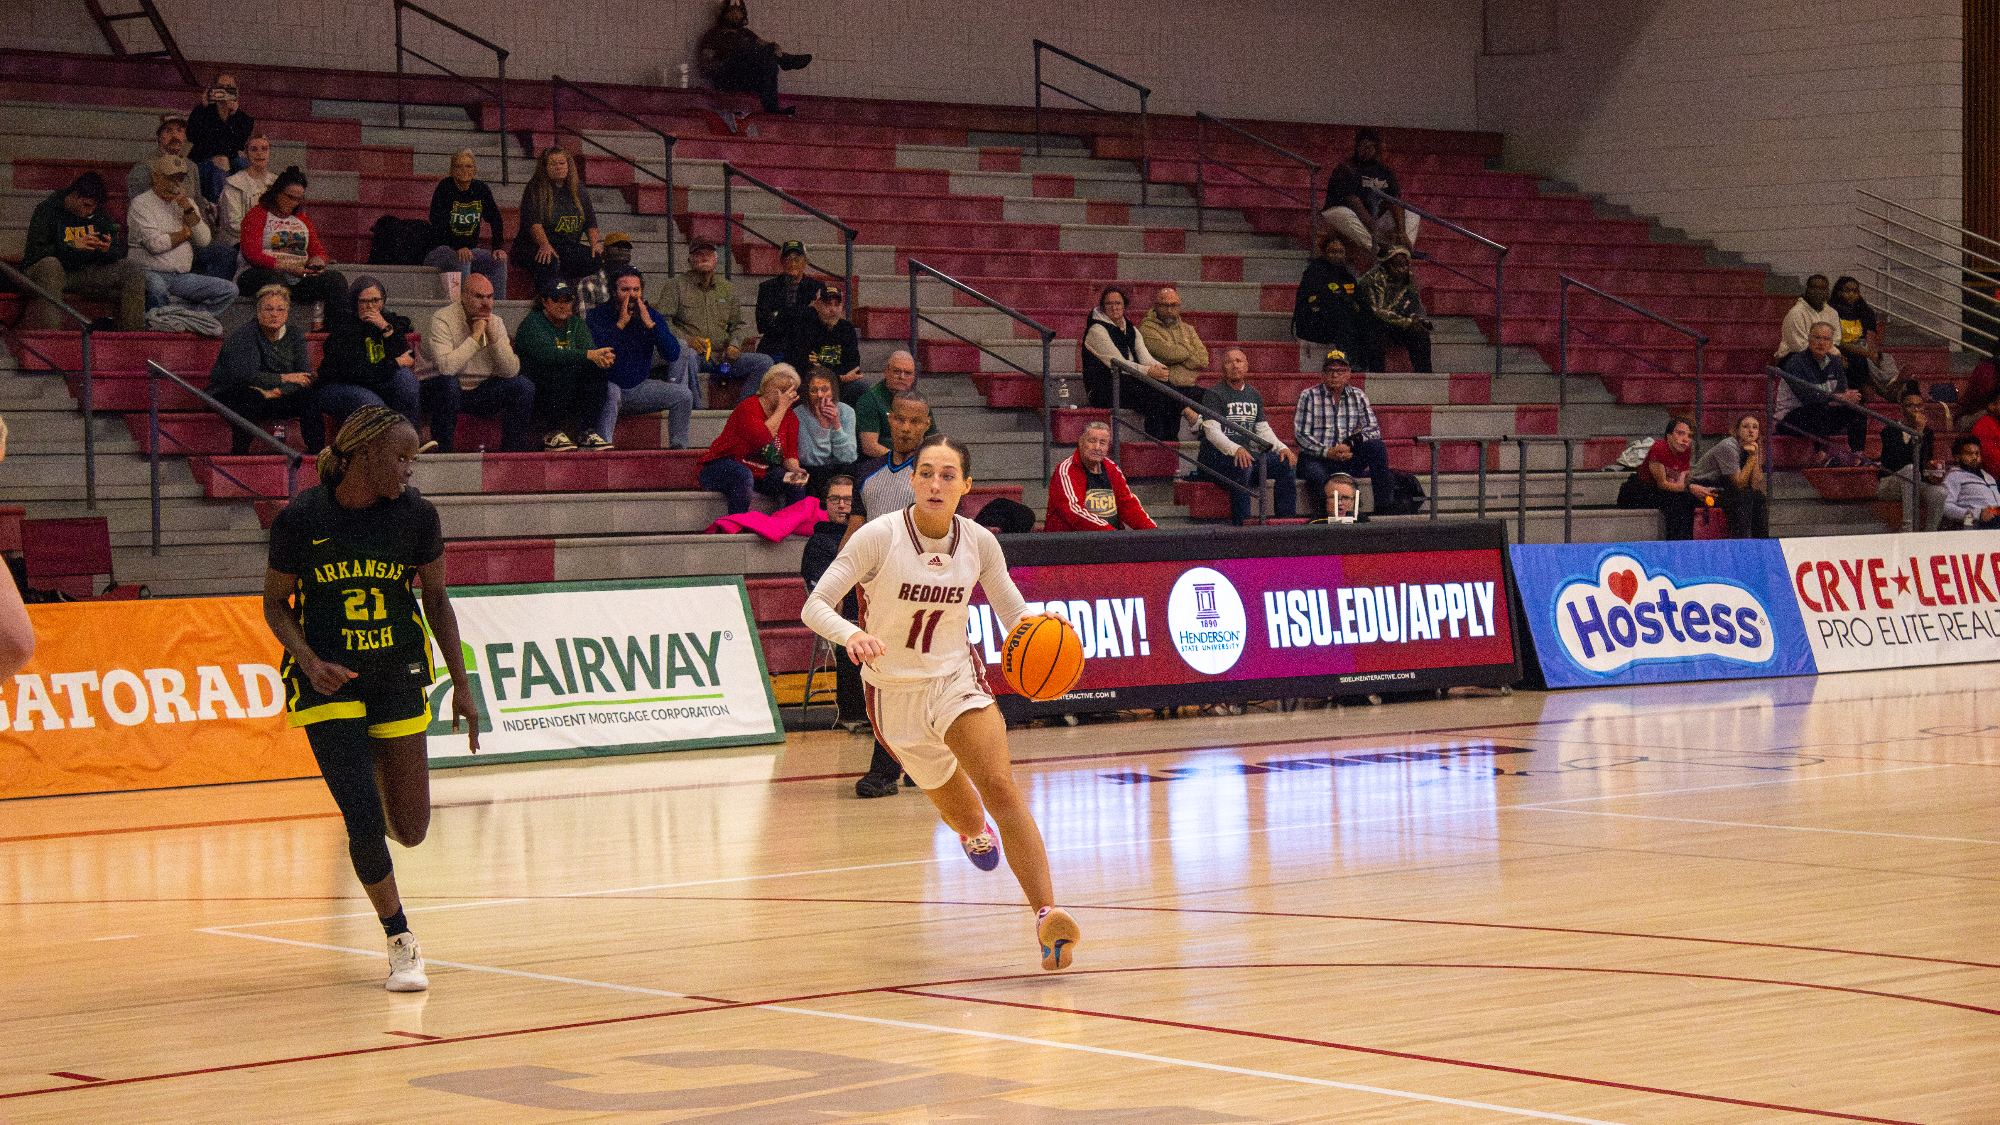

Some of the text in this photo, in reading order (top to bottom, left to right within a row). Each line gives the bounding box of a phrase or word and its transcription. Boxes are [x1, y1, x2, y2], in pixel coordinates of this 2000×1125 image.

[452, 212, 481, 224] TECH
[1227, 402, 1258, 416] TECH
[1090, 496, 1116, 509] TECH
[314, 559, 404, 583] ARKANSAS
[898, 583, 965, 604] REDDIES
[1796, 558, 1894, 613] CRYE
[341, 588, 387, 621] 21
[1263, 581, 1496, 648] HSU.EDU/APPLY
[341, 625, 394, 650] TECH
[905, 609, 945, 654] 11
[1201, 620, 1218, 628] 1890
[1566, 588, 1762, 659] Hostess
[1817, 609, 2000, 649] PRO ELITE REAL
[1202, 643, 1240, 651] UNIVERSITY
[485, 630, 722, 701] FAIRWAY
[0, 663, 287, 732] ATORAD
[502, 704, 731, 732] INDEPENDENT MORTGAGE CORPORATION
